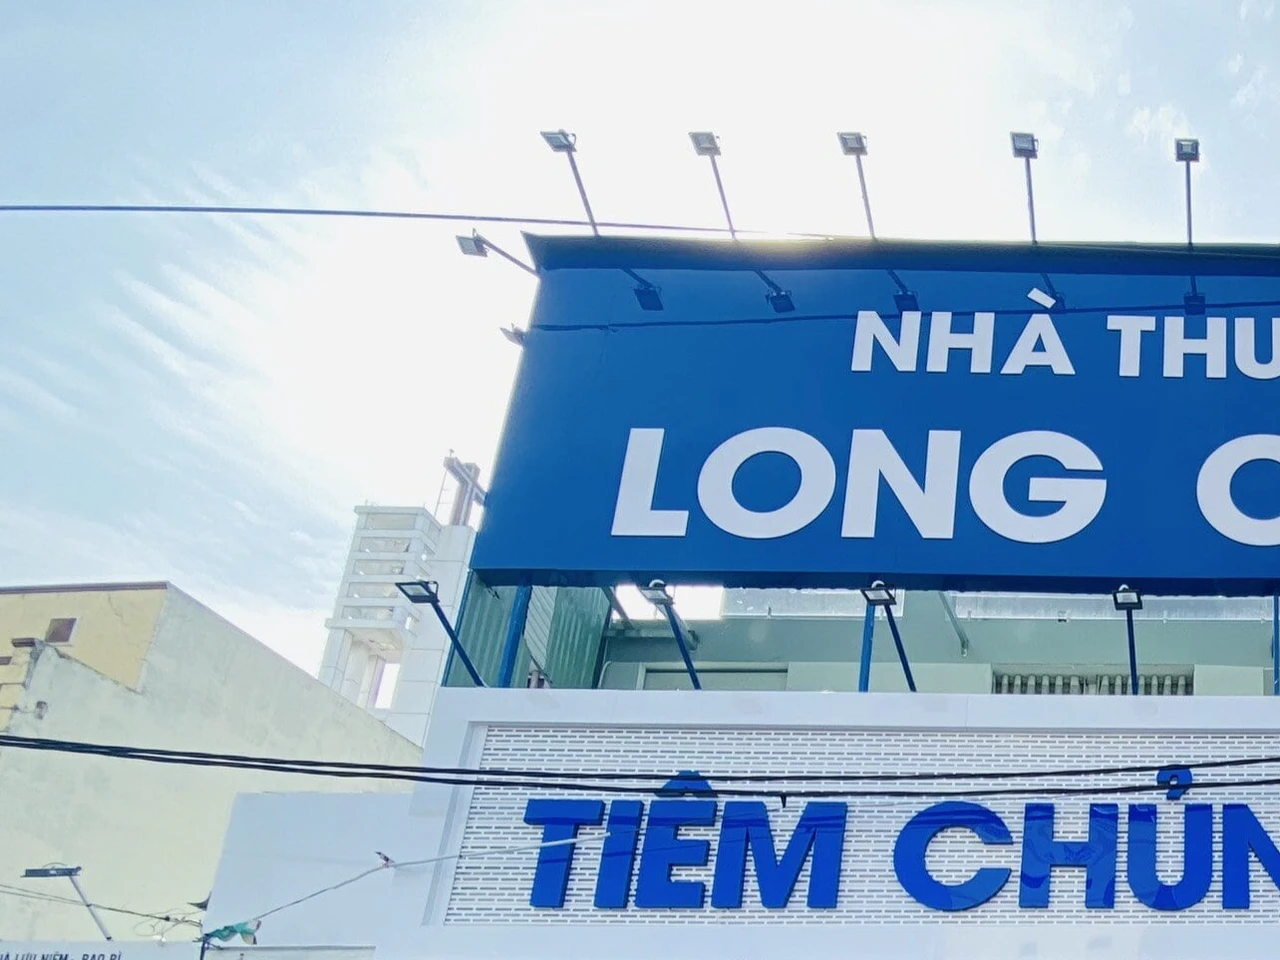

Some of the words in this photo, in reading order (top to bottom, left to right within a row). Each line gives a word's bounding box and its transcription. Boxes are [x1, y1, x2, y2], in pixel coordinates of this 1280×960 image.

[851, 287, 1076, 375] NHÀ
[611, 426, 1107, 544] LONG
[523, 769, 847, 909] TIÊM
